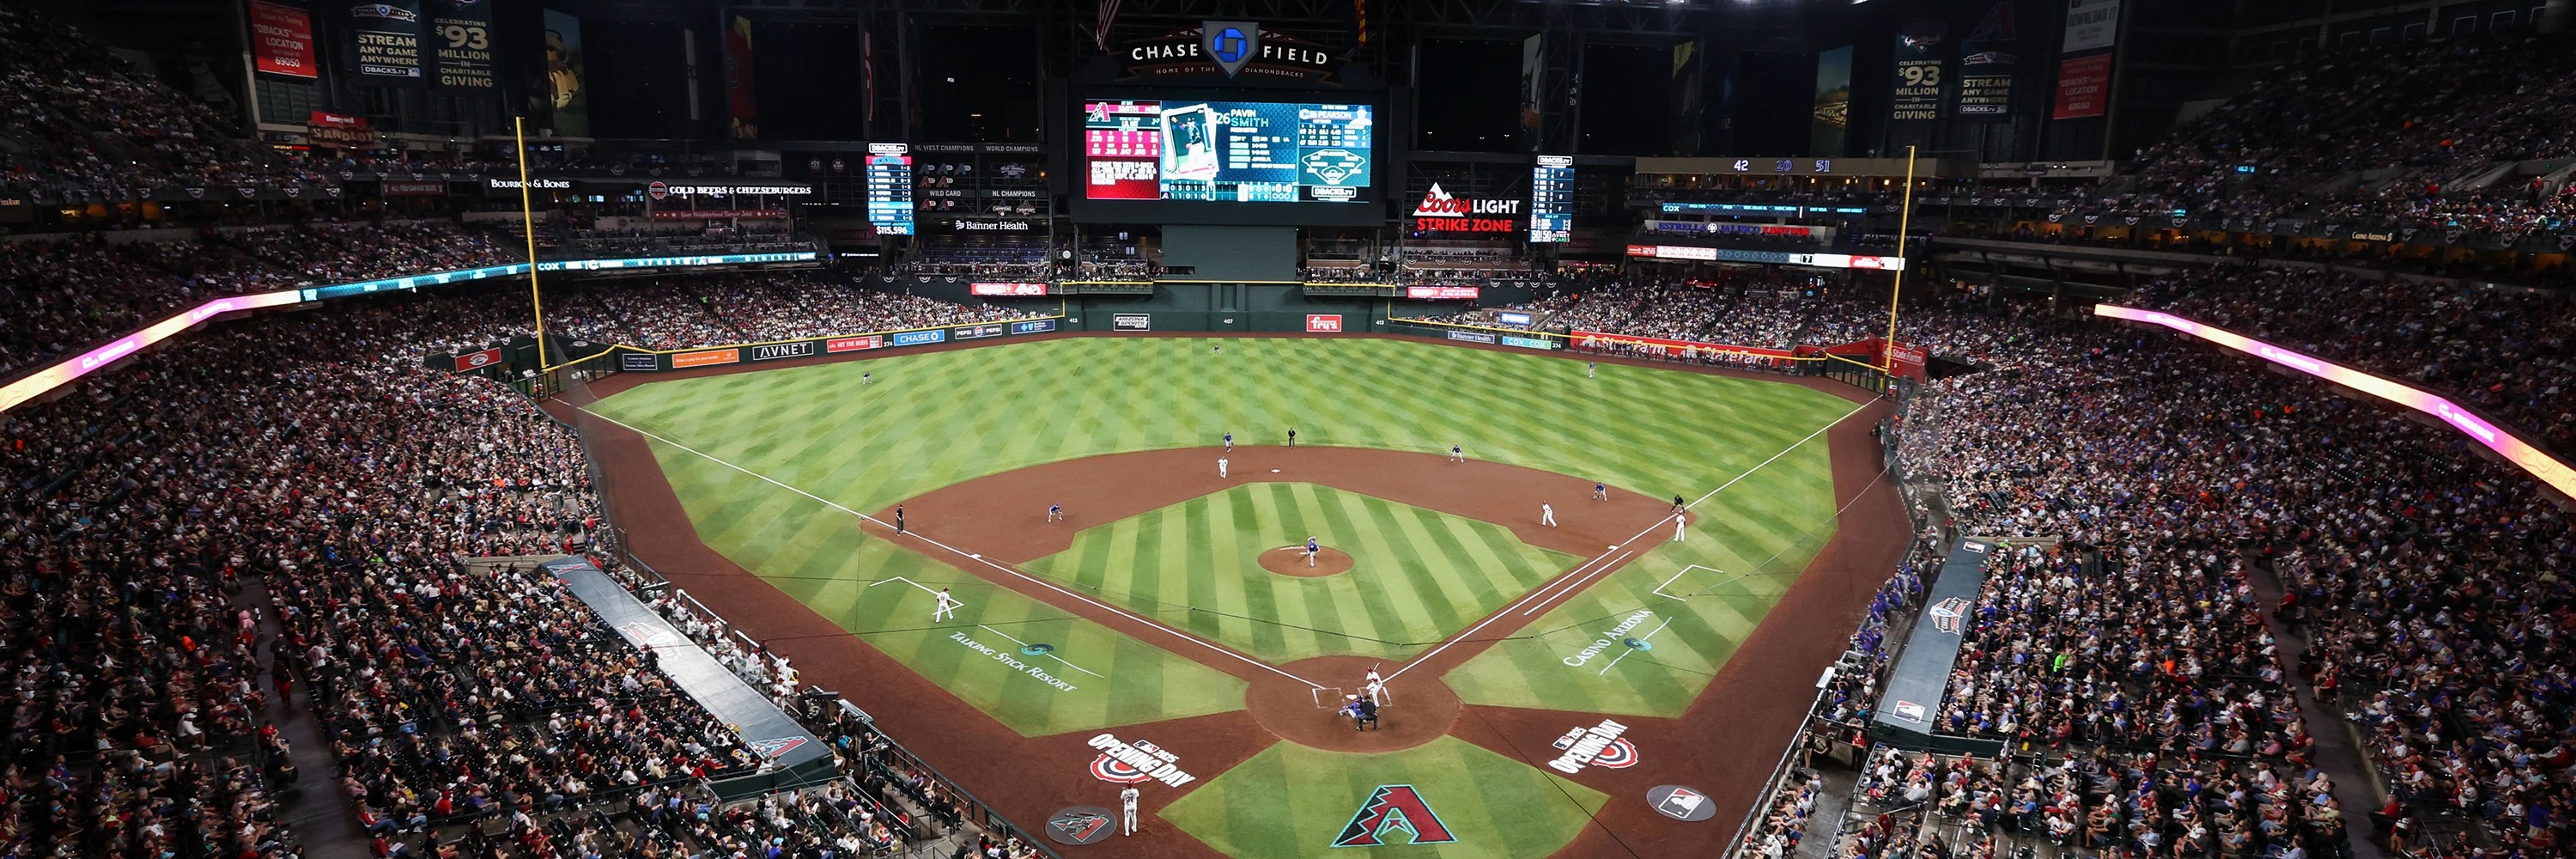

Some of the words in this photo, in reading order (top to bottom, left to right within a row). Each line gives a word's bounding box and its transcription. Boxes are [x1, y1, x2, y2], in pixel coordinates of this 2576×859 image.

[434, 18, 486, 27] CELEBRATING
[358, 34, 416, 47] STREAM
[436, 25, 488, 49] $93
[266, 37, 304, 50] LOCATION
[360, 46, 383, 54] ANY
[386, 48, 418, 56] GAME
[438, 49, 490, 60] MILLION
[1132, 44, 1198, 60] CHASE
[1263, 46, 1327, 65] FIELD
[275, 56, 301, 67] 69050
[361, 55, 419, 65] ANYWHERE
[440, 68, 491, 76] CHARITABLE
[1245, 67, 1304, 78] DIAMONDBACKS
[1898, 66, 1940, 86] $93
[442, 76, 493, 87] GIVING
[1963, 79, 2011, 87] STREAM
[1215, 113, 1231, 125] 26
[1230, 109, 1257, 117] PAVIN
[1318, 111, 1352, 119] PEARSON
[1893, 111, 1935, 119] GIVING
[1231, 118, 1269, 128] SMITH
[313, 128, 374, 141] SANDLOT
[1734, 159, 1750, 171] 42
[1776, 159, 1793, 172] 20
[1815, 160, 1831, 172] 51
[533, 180, 542, 188] &
[544, 180, 570, 189] BONES
[669, 186, 695, 195] COLD
[697, 186, 727, 195] BEERS
[736, 186, 811, 195] CHEESEBURGERS
[1418, 191, 1471, 213] Coors
[1473, 199, 1520, 214] LIGHT
[876, 226, 908, 235] $115,596
[966, 222, 998, 230] Banner
[999, 221, 1028, 230] Health
[1417, 218, 1469, 232] STRIKE
[1472, 219, 1513, 232] ZONE
[1659, 222, 1706, 232] ESTRELLA
[1718, 224, 1760, 234] JALISCO
[538, 262, 560, 271] COX
[1310, 316, 1338, 330] fry's
[900, 333, 930, 343] CHASE
[760, 344, 807, 358] AVNET
[1893, 348, 1907, 359] State
[1906, 352, 1922, 362] Farm
[1563, 639, 1612, 667] CASINO
[1603, 610, 1653, 640] ARIZONA
[949, 631, 996, 656] TALKING
[993, 652, 1029, 671] STICK
[1026, 667, 1077, 692] RESORT
[1566, 726, 1587, 741] 2025
[1548, 732, 1610, 774] OPENING
[1588, 719, 1628, 743] DAY
[1087, 733, 1157, 773] OPENING
[1148, 762, 1196, 788] DAY
[1152, 749, 1180, 763] 2025
